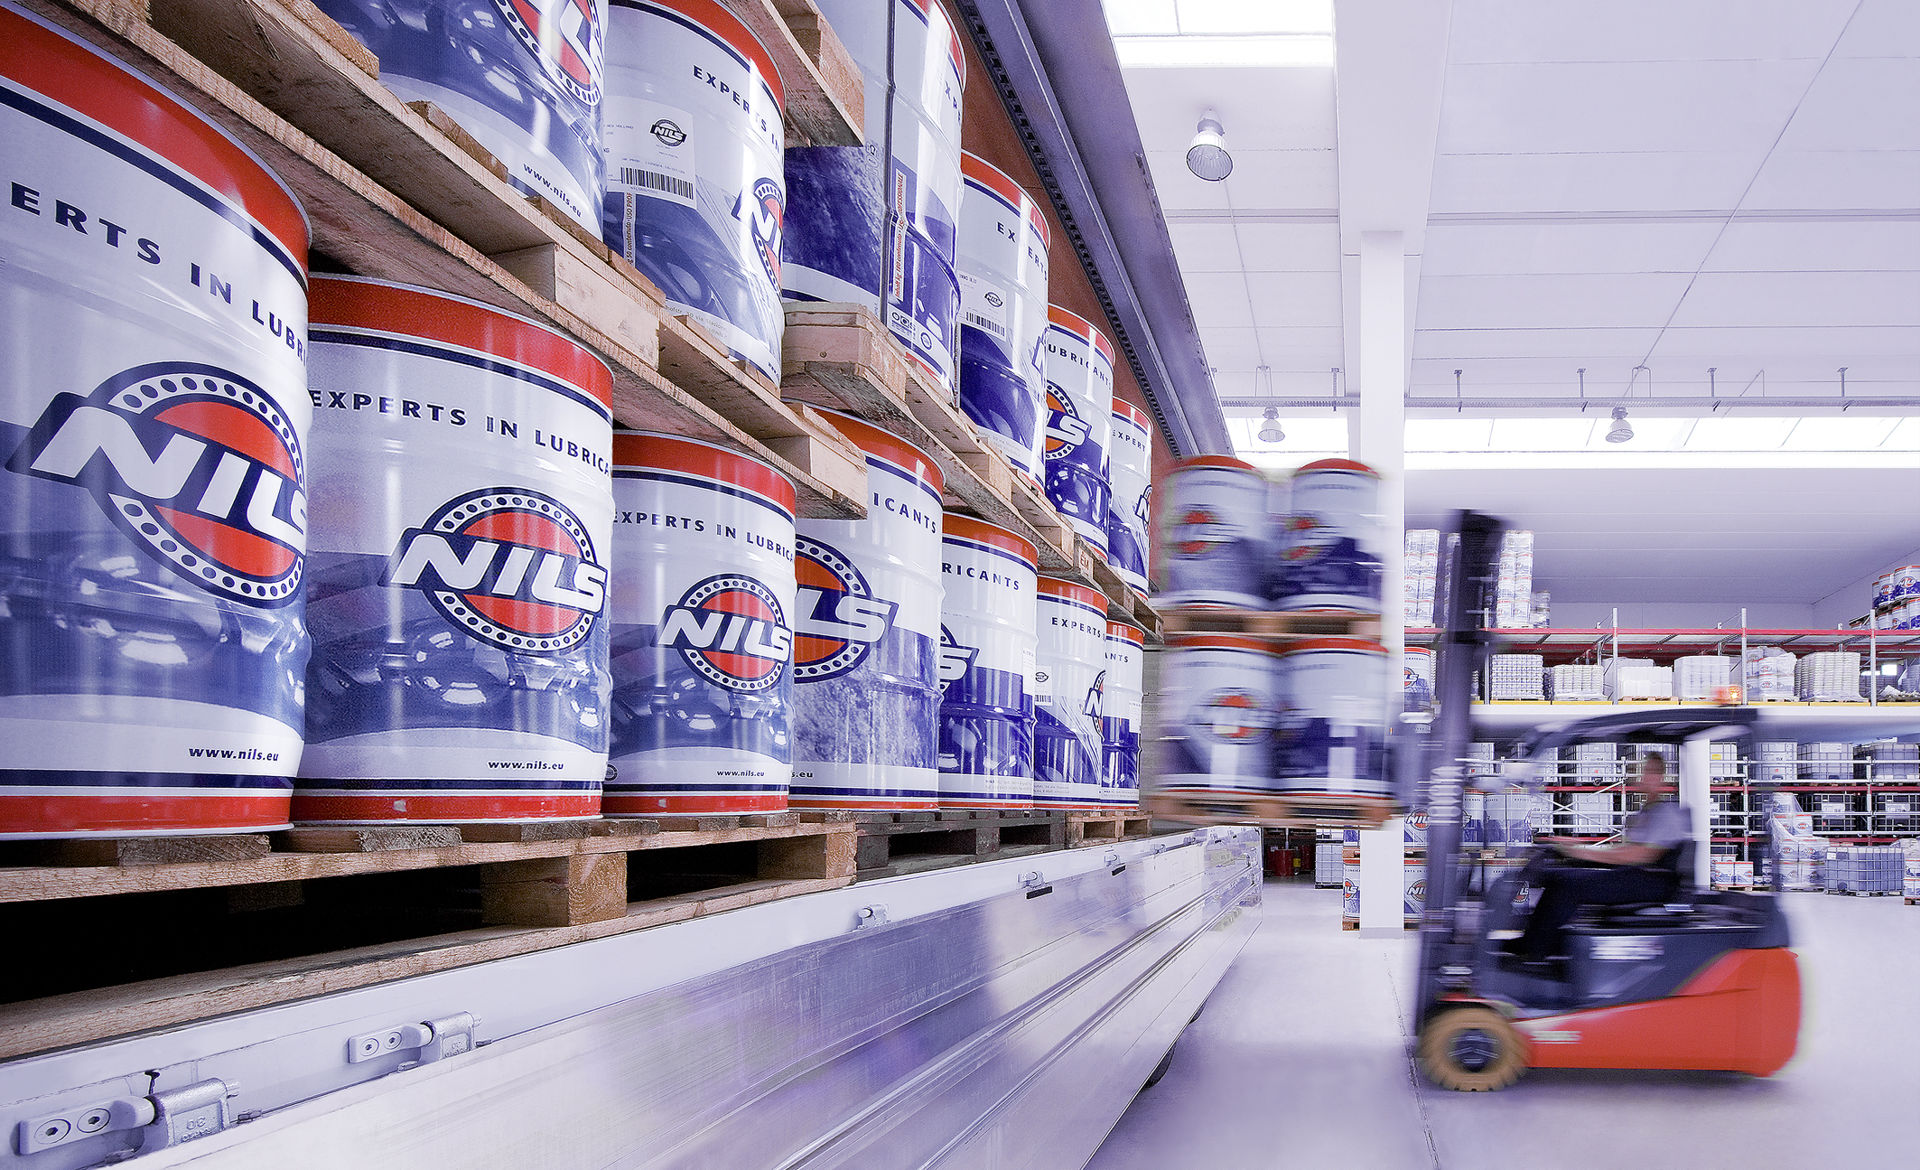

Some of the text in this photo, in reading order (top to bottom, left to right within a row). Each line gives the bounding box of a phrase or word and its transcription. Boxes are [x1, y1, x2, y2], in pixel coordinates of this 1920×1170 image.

[653, 125, 685, 141] NILS
[523, 163, 582, 218] www.nils.eu
[11, 181, 162, 265] ERTS
[190, 262, 232, 305] IN
[307, 388, 467, 426] EXPERTS
[486, 416, 518, 439] IN
[716, 524, 737, 539] IN
[390, 533, 608, 614] NILS
[657, 608, 791, 662] NILS
[1051, 617, 1101, 638] EXPERTS
[188, 745, 279, 763] www.nils.eu
[487, 761, 565, 771] www.nils.eu
[716, 769, 765, 777] www.nils.eu
